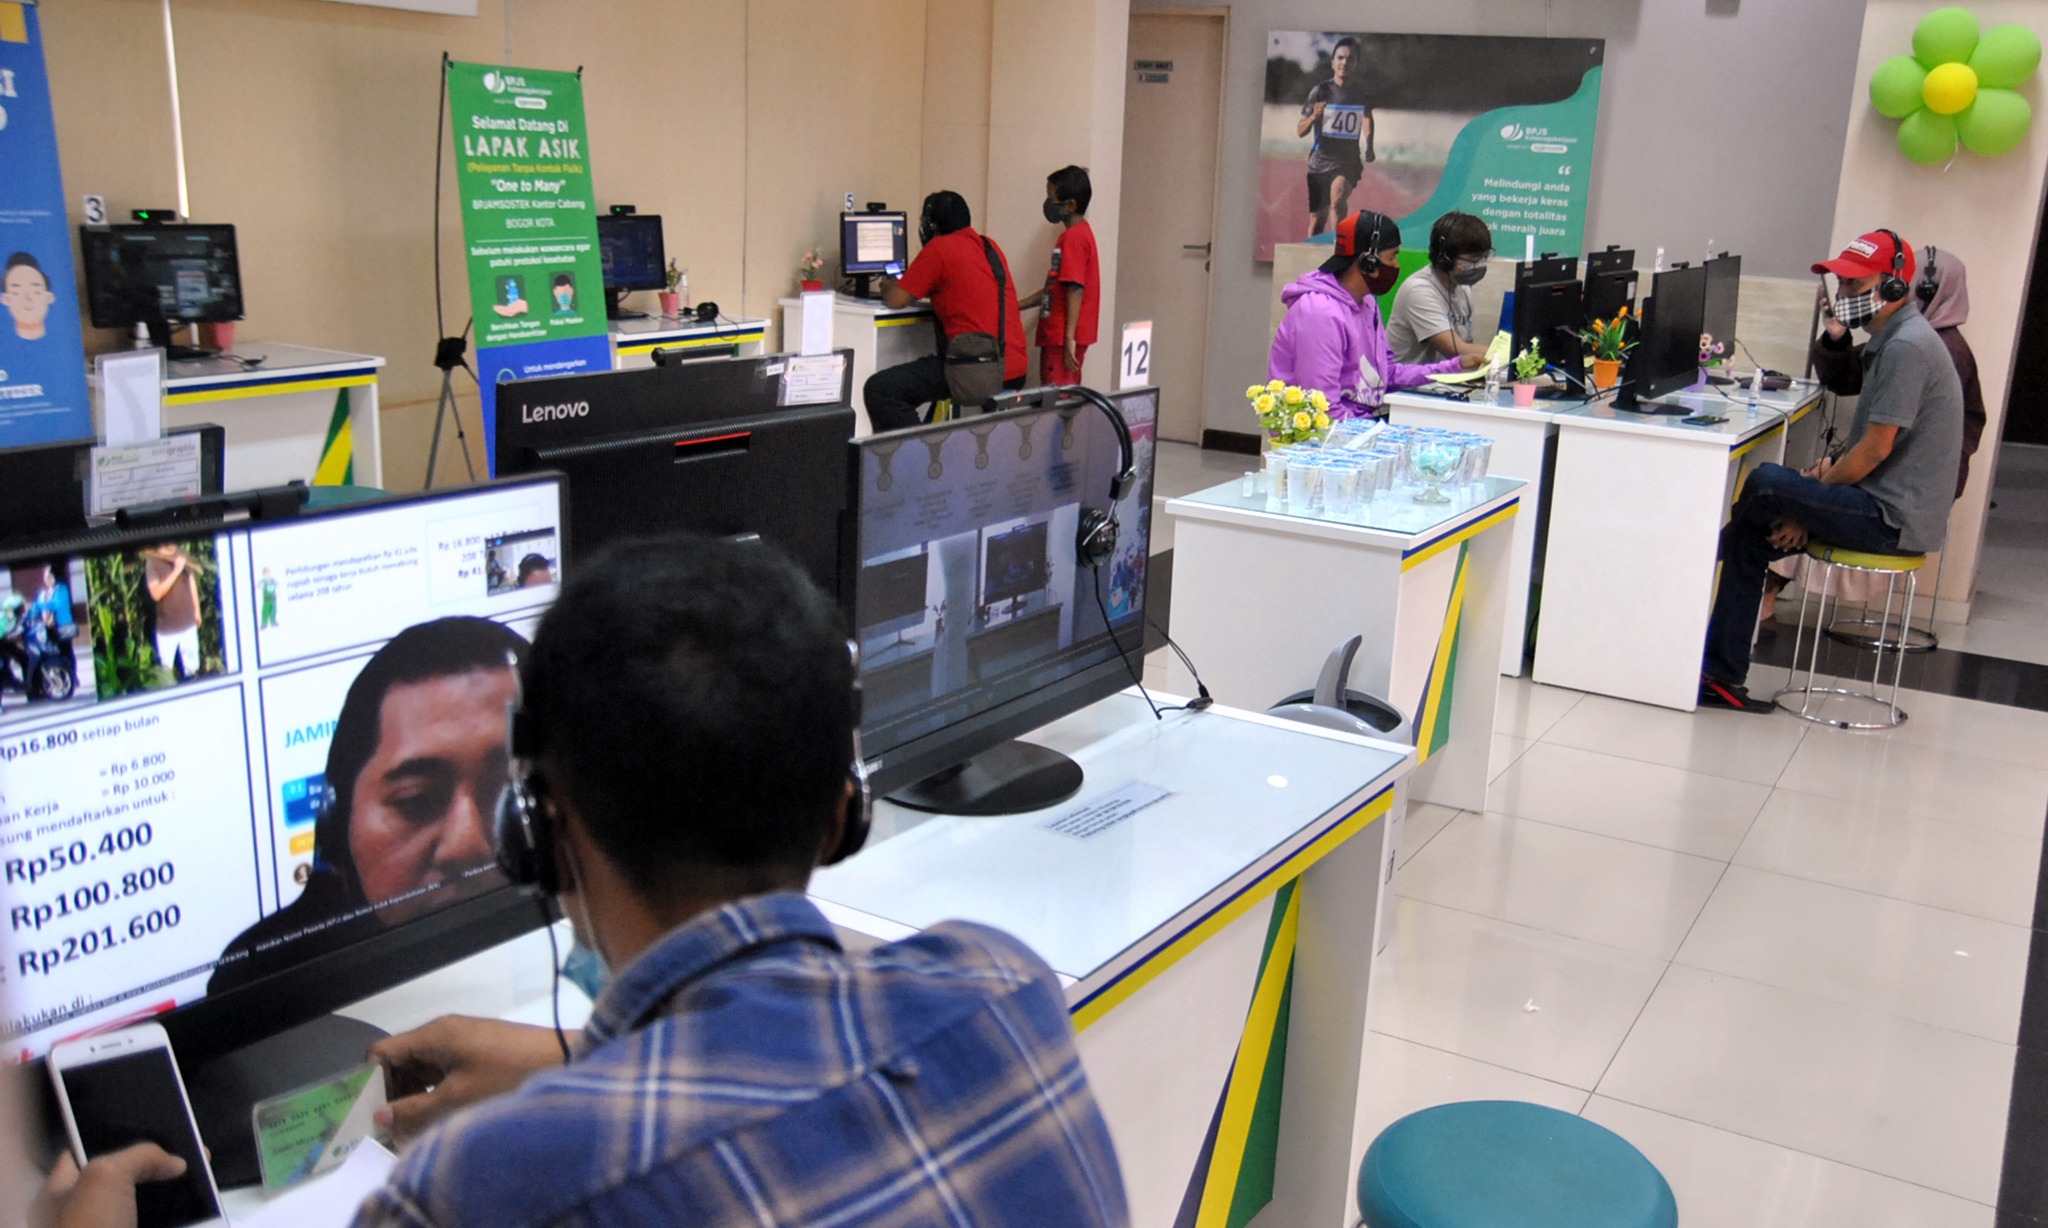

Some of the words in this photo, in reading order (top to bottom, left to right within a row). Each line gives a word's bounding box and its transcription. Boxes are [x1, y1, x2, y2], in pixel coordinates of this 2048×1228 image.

[505, 75, 526, 87] BPJS
[471, 115, 517, 130] Selamat
[518, 118, 555, 135] Datang
[557, 119, 569, 132] Di
[1331, 111, 1358, 133] 40
[1525, 127, 1548, 136] BPJS
[464, 135, 529, 158] LAPAK
[538, 137, 581, 159] ASIK
[512, 163, 535, 173] Tanpa
[535, 164, 562, 173] Kontak
[521, 180, 532, 191] to
[1484, 178, 1542, 192] Melindungi
[1543, 183, 1570, 192] anda
[86, 197, 103, 222] 3
[532, 200, 556, 209] Kantor
[557, 199, 586, 210] Cabang
[846, 193, 854, 210] 5
[1471, 193, 1496, 203] yang
[1499, 194, 1538, 205] bekerja
[1540, 196, 1569, 207] keras
[505, 218, 534, 229] BOGOR
[535, 217, 556, 227] KOTA
[1482, 207, 1521, 219] dengan
[1524, 210, 1567, 222] totalitas
[1501, 223, 1536, 233] meraih
[1539, 225, 1566, 236] juara
[471, 247, 501, 256] Sebelum
[502, 245, 539, 254] melakukan
[540, 244, 575, 253] wawancara
[575, 244, 591, 253] agar
[490, 258, 513, 268] patuhi
[513, 257, 543, 267] protokol
[543, 255, 576, 264] kesehatan
[523, 364, 543, 374] Untuk
[543, 359, 587, 371] mendengarkan
[1124, 340, 1149, 376] 12
[522, 401, 589, 424] Lenovo
[82, 724, 121, 742] setiap
[124, 713, 160, 731] bulan
[111, 763, 128, 776] Rp
[131, 752, 166, 771] 6.800
[113, 782, 130, 796] Rp
[134, 769, 175, 790] 10.000
[0, 813, 20, 826] an
[25, 801, 59, 820] Kerja
[0, 828, 33, 847] sung
[37, 803, 129, 836] mendaftarkan
[133, 790, 169, 810] untuk
[5, 822, 153, 885] Rp50.400
[10, 861, 175, 932] Rp100.800
[18, 904, 182, 977] Rp201.600
[2, 1004, 68, 1034] ilakukan
